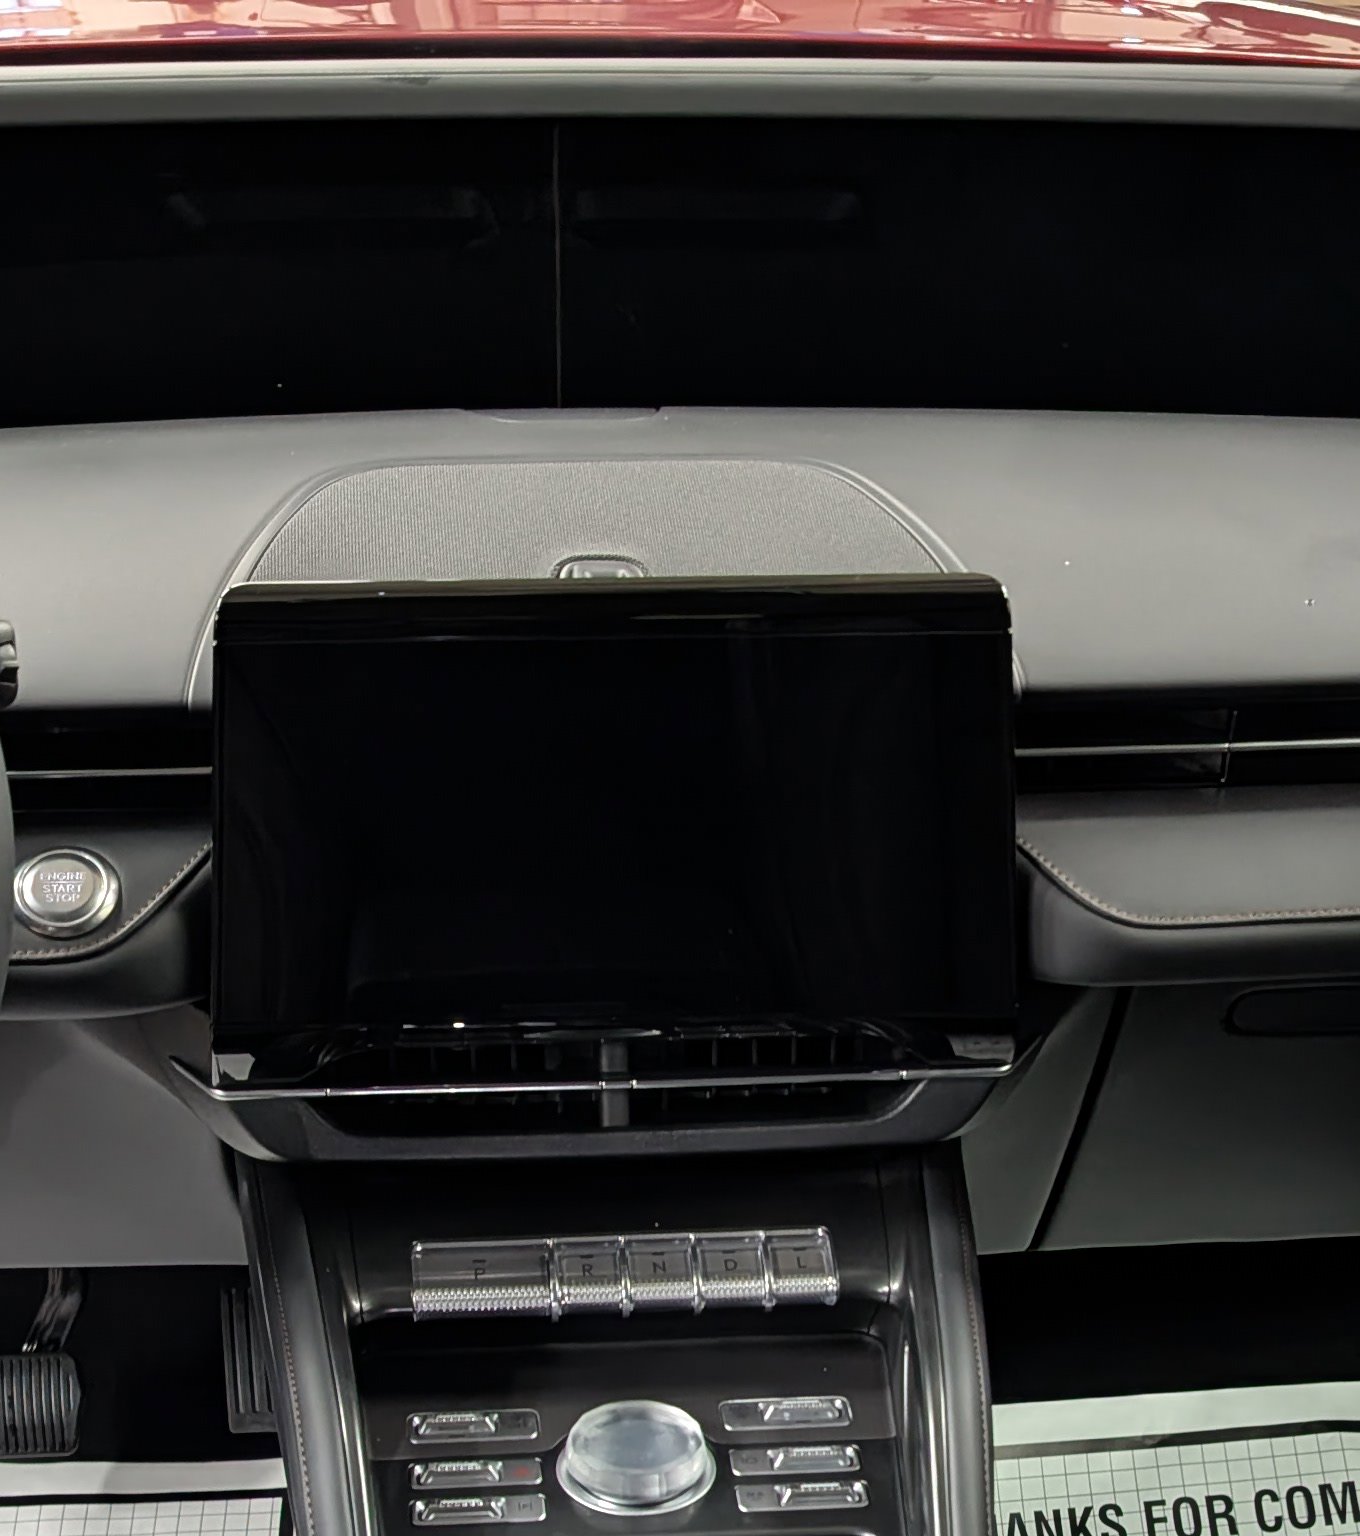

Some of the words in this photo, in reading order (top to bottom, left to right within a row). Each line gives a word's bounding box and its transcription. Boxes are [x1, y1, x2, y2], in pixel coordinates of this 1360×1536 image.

[40, 871, 88, 881] ENGINE
[42, 883, 83, 894] START
[45, 892, 81, 903] STOP
[473, 1267, 486, 1281] P
[582, 1263, 594, 1277] R
[652, 1260, 667, 1274] N
[724, 1258, 738, 1272] D
[797, 1256, 807, 1270] L
